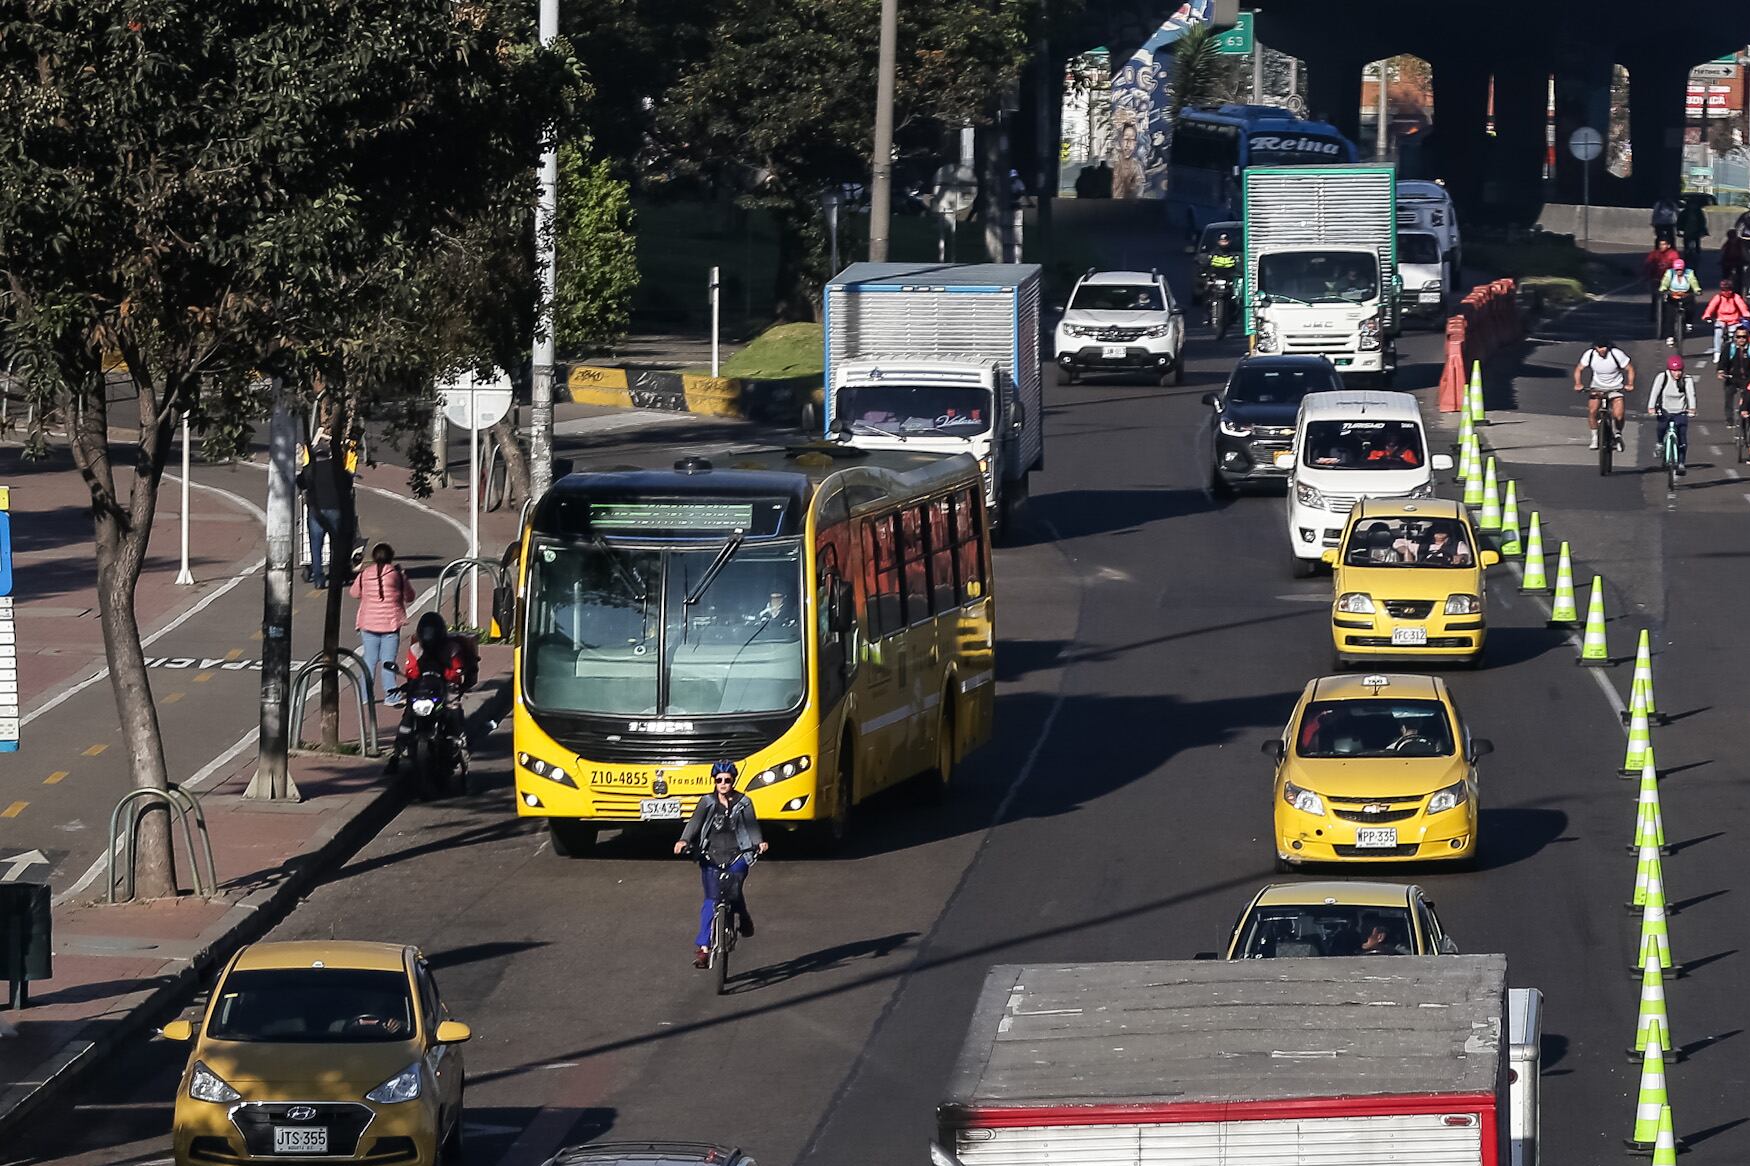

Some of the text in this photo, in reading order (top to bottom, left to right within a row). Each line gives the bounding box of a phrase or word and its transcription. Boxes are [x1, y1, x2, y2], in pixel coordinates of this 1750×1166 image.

[1249, 136, 1340, 155] Reina
[1342, 422, 1386, 430] TURISMO
[591, 770, 649, 786] Z10-4855
